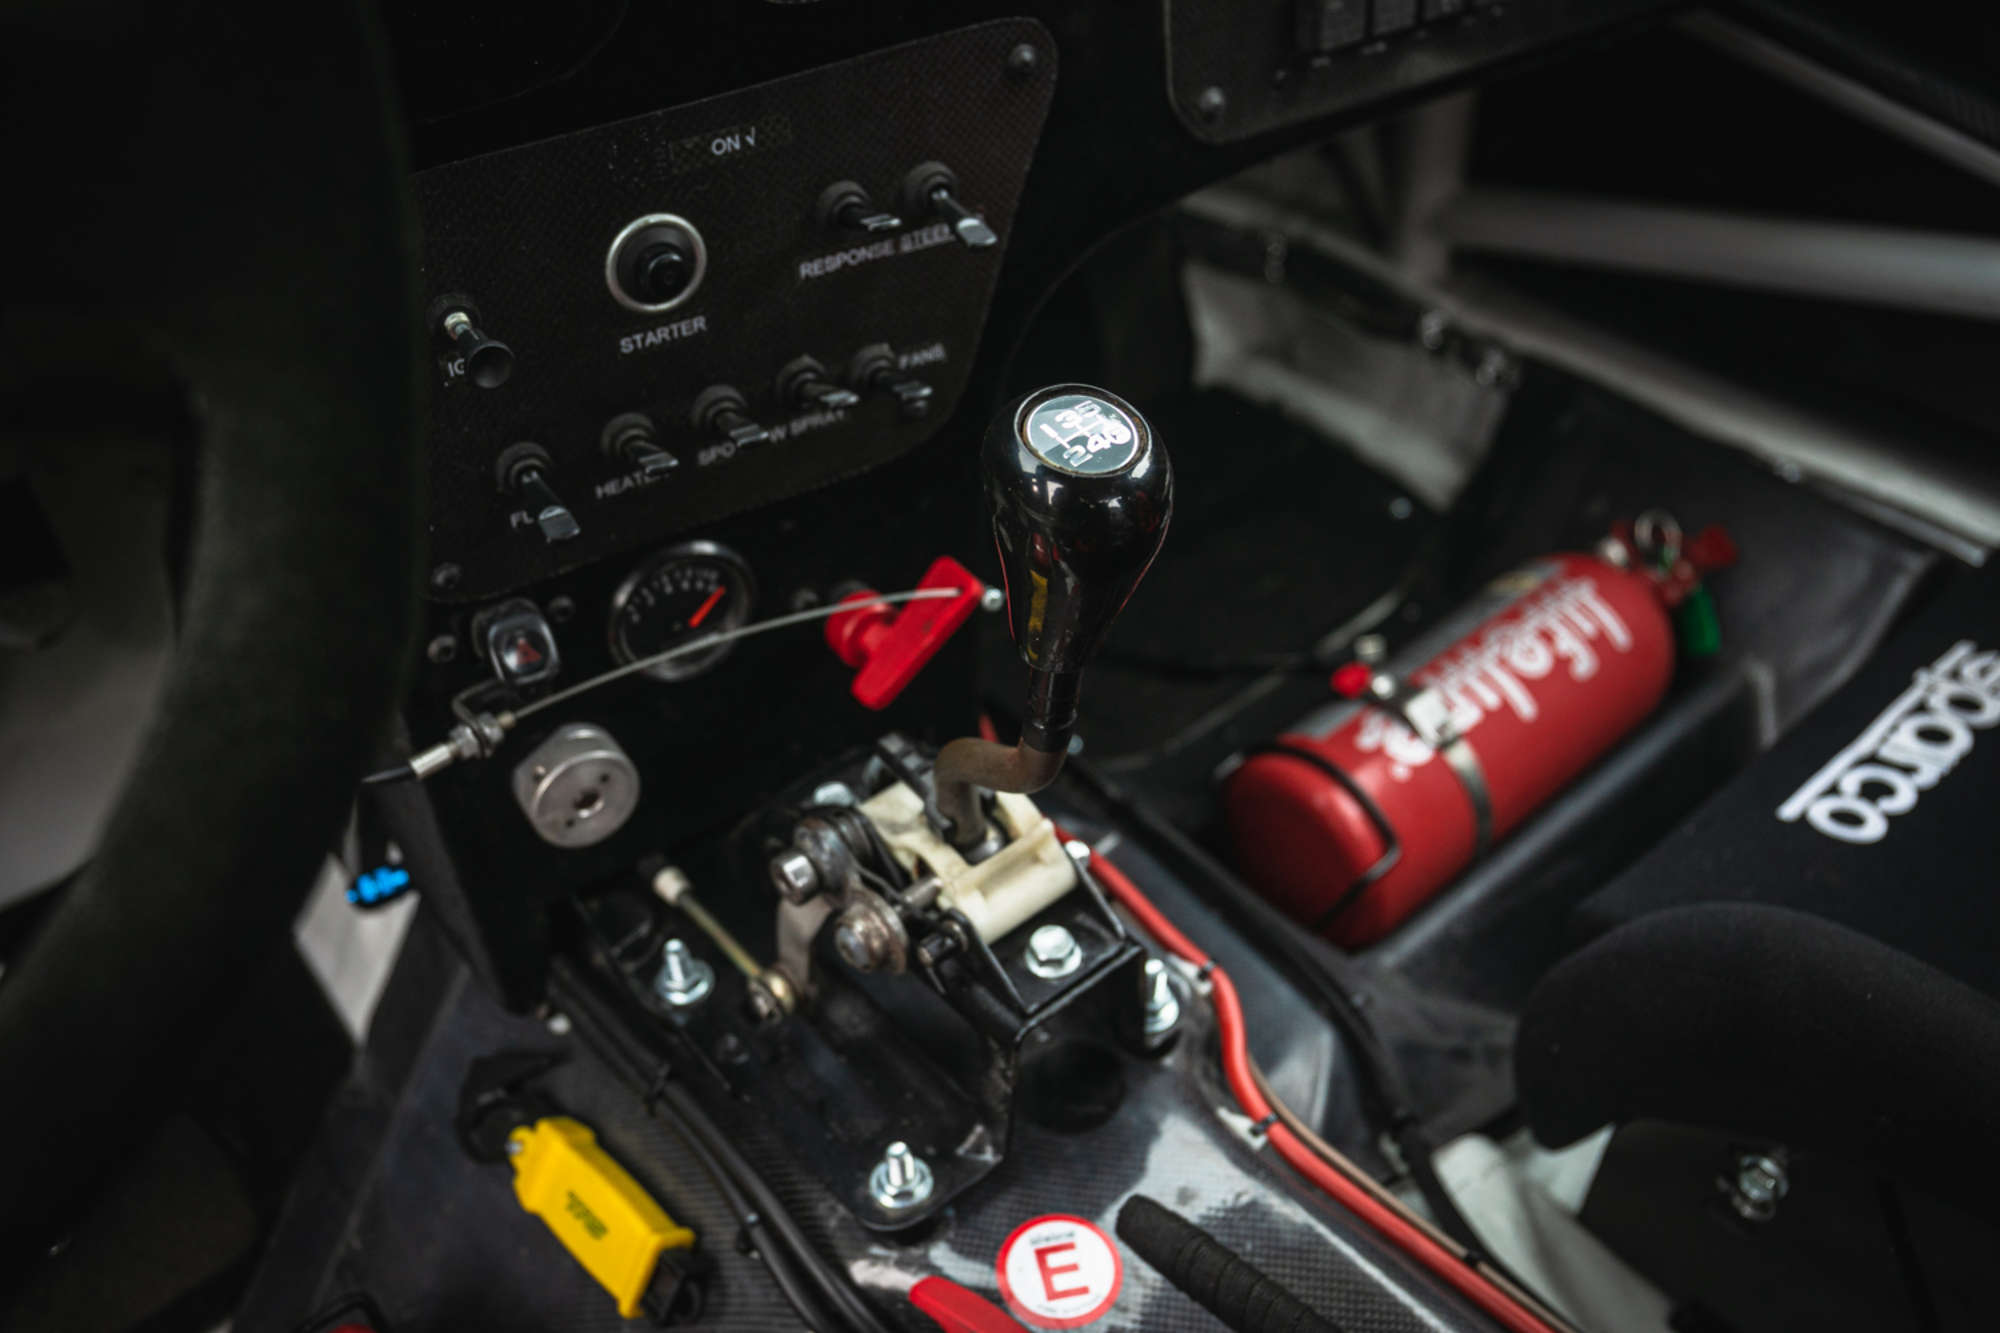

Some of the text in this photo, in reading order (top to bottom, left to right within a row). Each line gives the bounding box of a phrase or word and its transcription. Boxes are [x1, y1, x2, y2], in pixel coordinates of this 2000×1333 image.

[711, 133, 741, 156] ON
[799, 239, 894, 279] RESPONSE
[619, 315, 707, 354] STARTER
[897, 343, 948, 370] FANS
[696, 440, 737, 466] SPO
[1034, 1242, 1090, 1302] E
